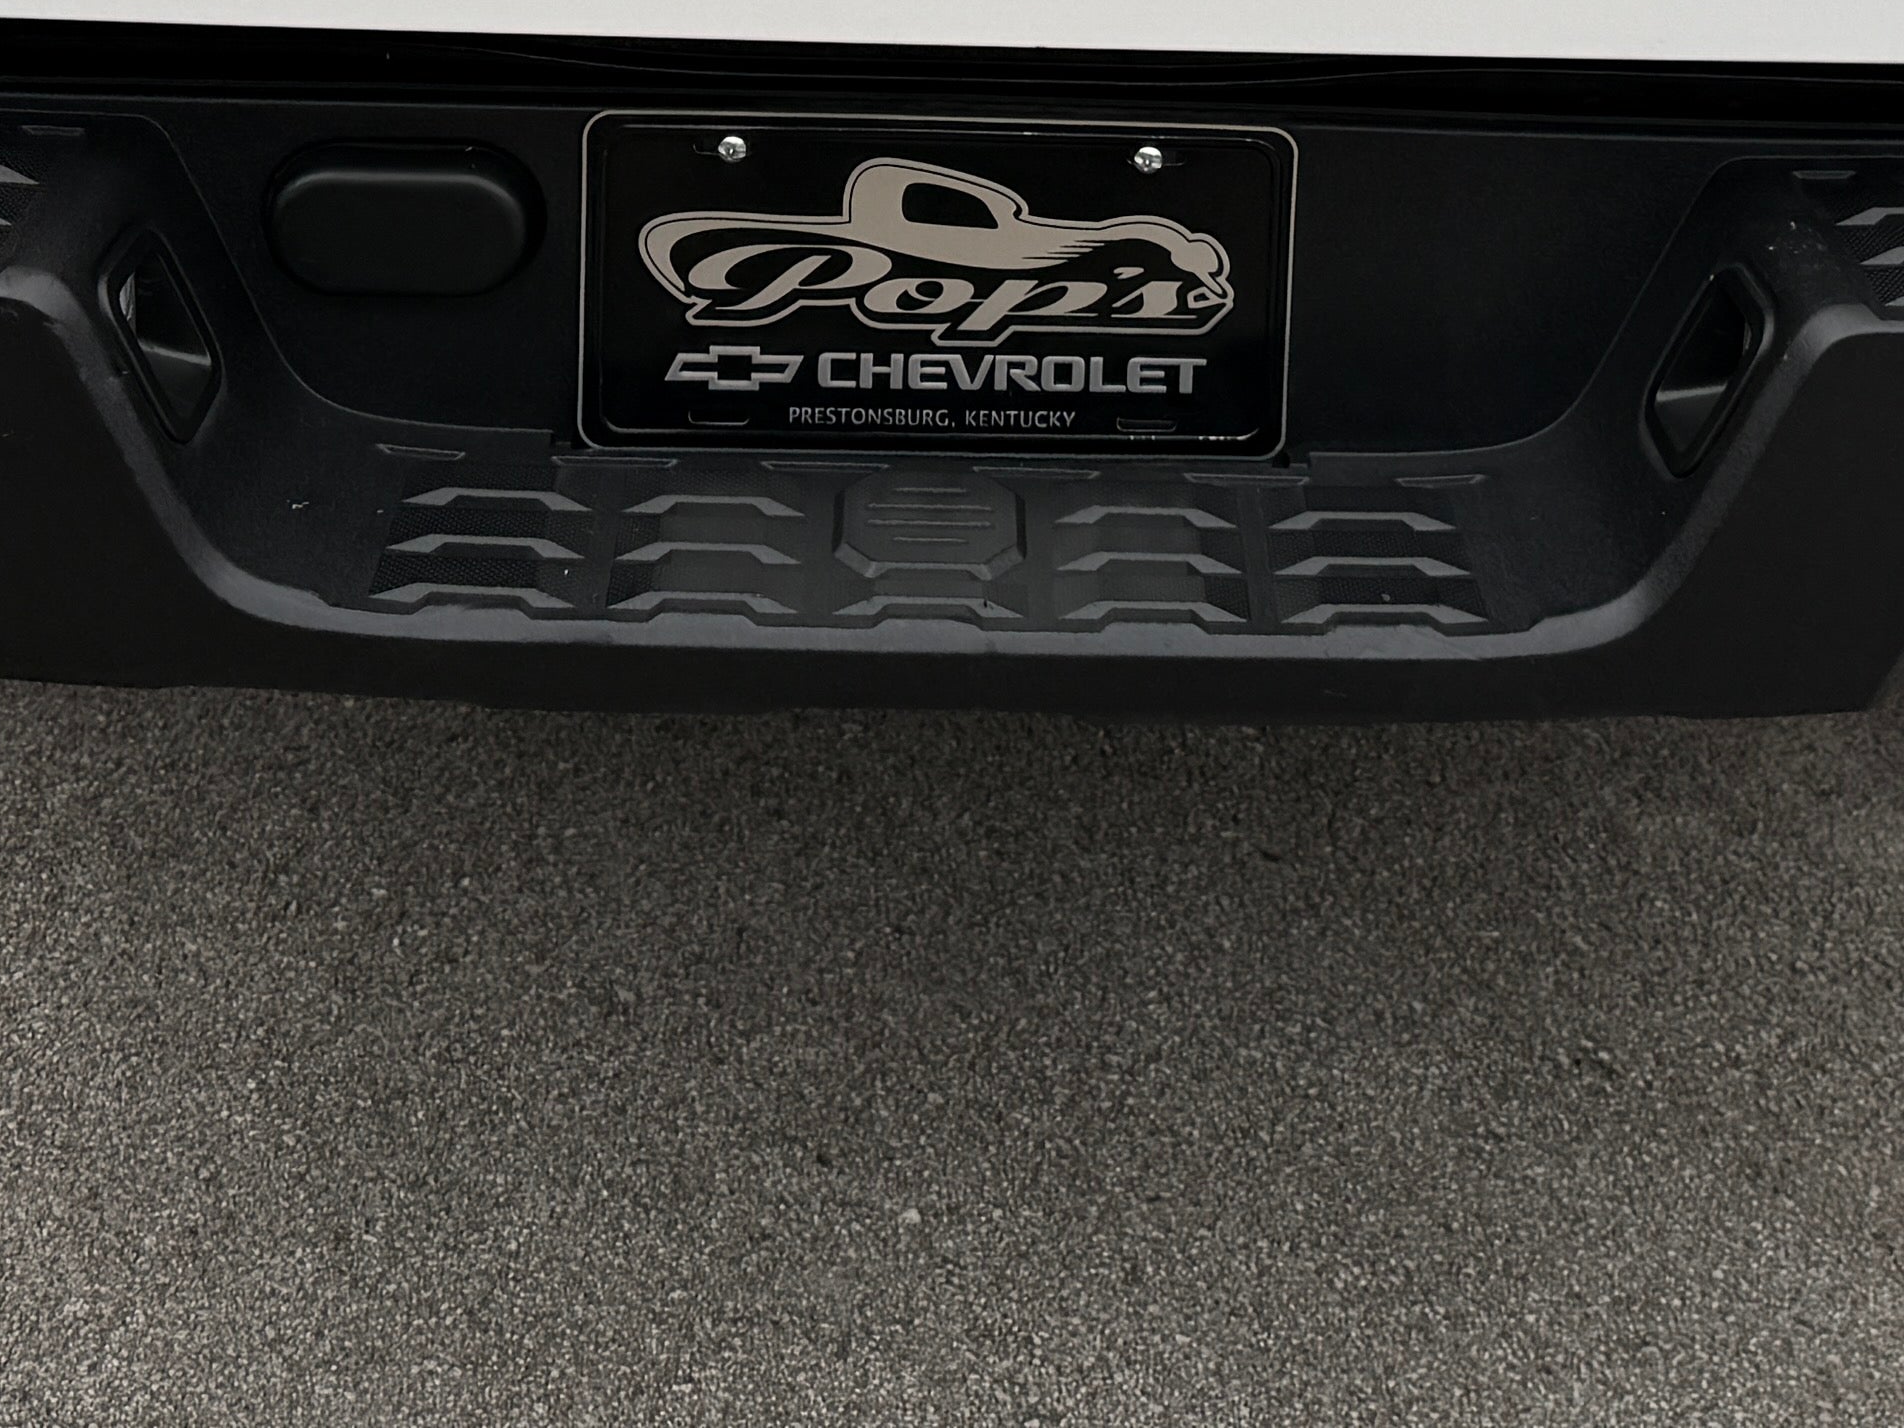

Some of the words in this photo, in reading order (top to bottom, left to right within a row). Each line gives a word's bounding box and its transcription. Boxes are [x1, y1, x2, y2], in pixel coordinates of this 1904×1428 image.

[688, 242, 1198, 332] Pop's
[816, 350, 1208, 395] CHEVROLET
[788, 406, 957, 429] PRESTONSBURG,
[964, 409, 1077, 430] KENTUCKY
